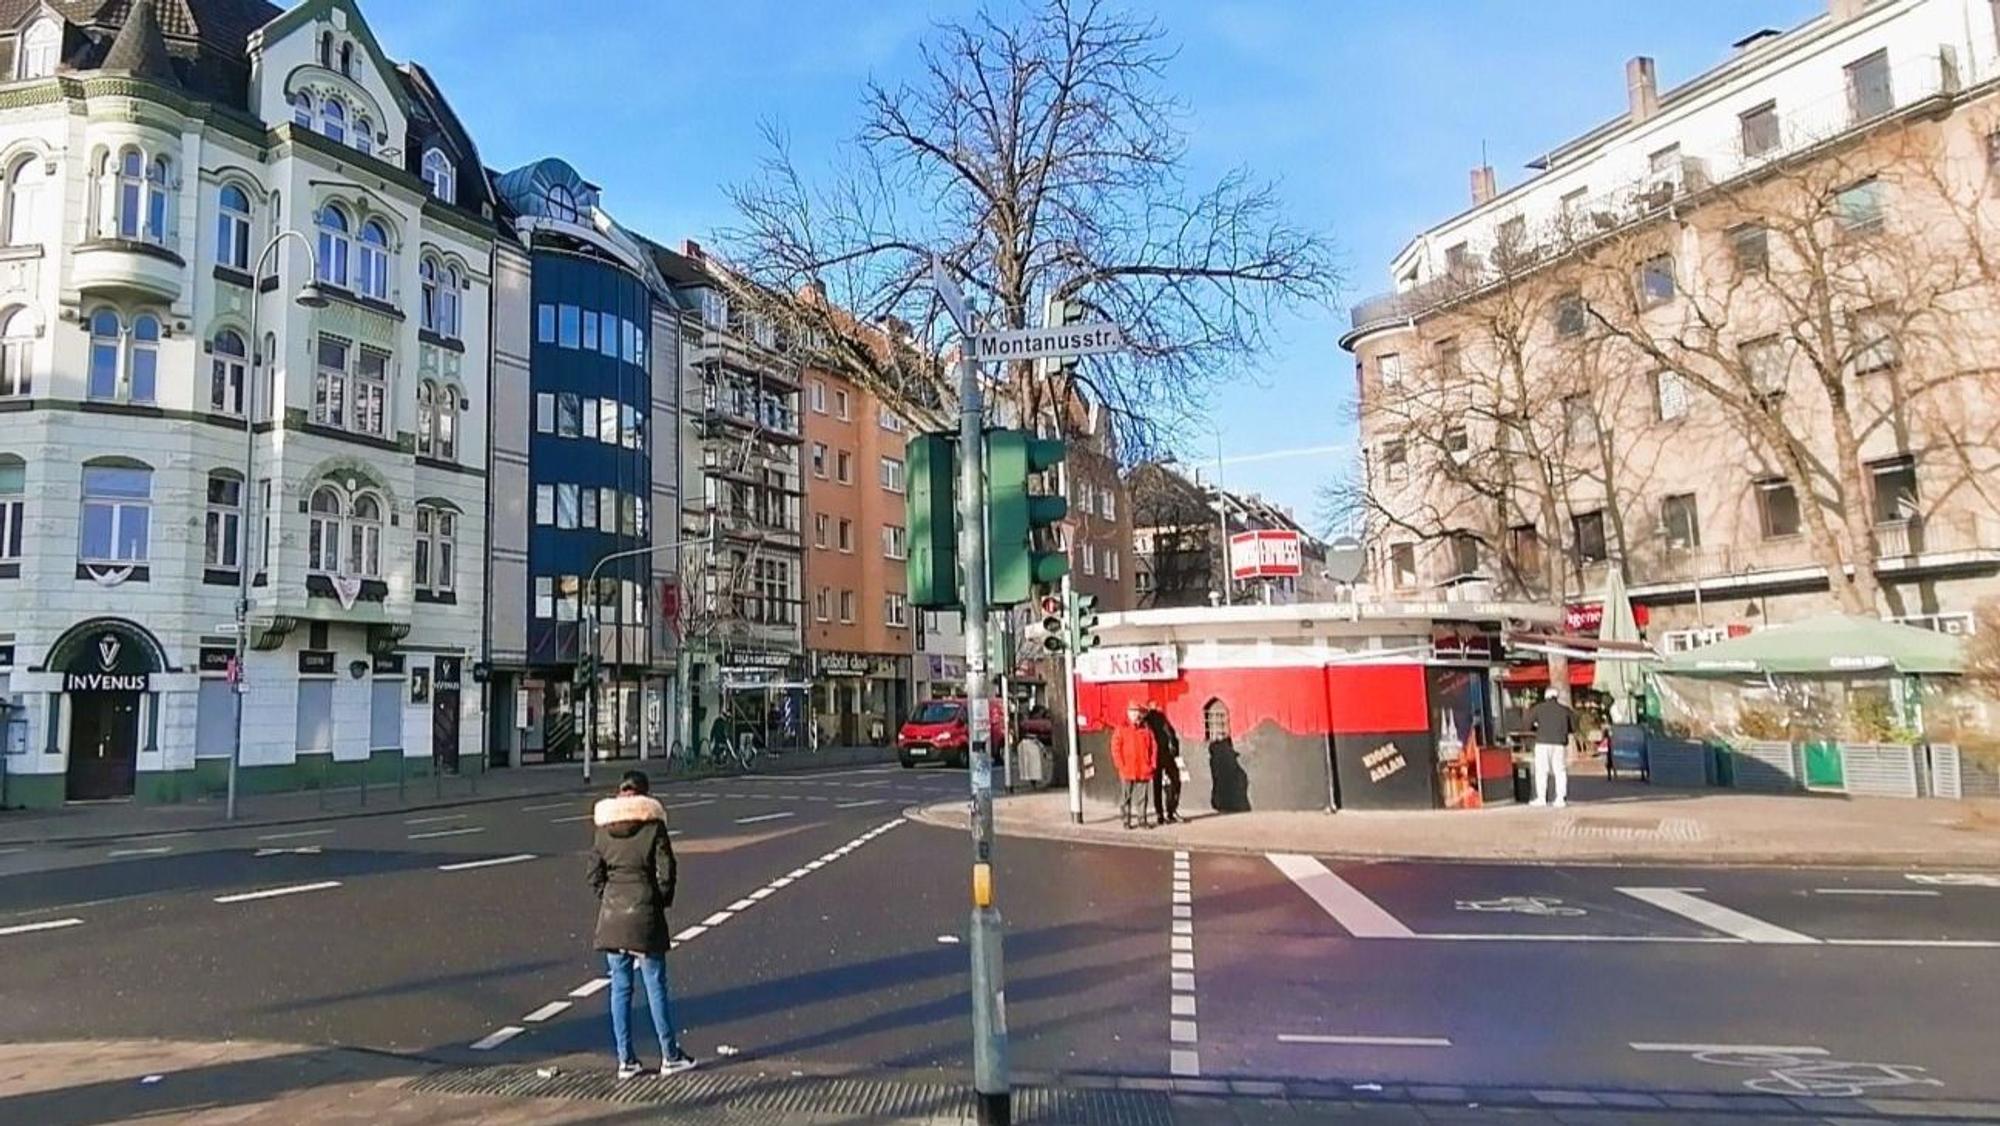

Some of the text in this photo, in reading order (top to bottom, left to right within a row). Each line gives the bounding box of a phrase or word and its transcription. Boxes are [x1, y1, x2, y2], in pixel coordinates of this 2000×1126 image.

[981, 329, 1117, 356] Montanusstr.
[1110, 652, 1164, 675] Kiosk
[1361, 742, 1398, 768] KIOSK
